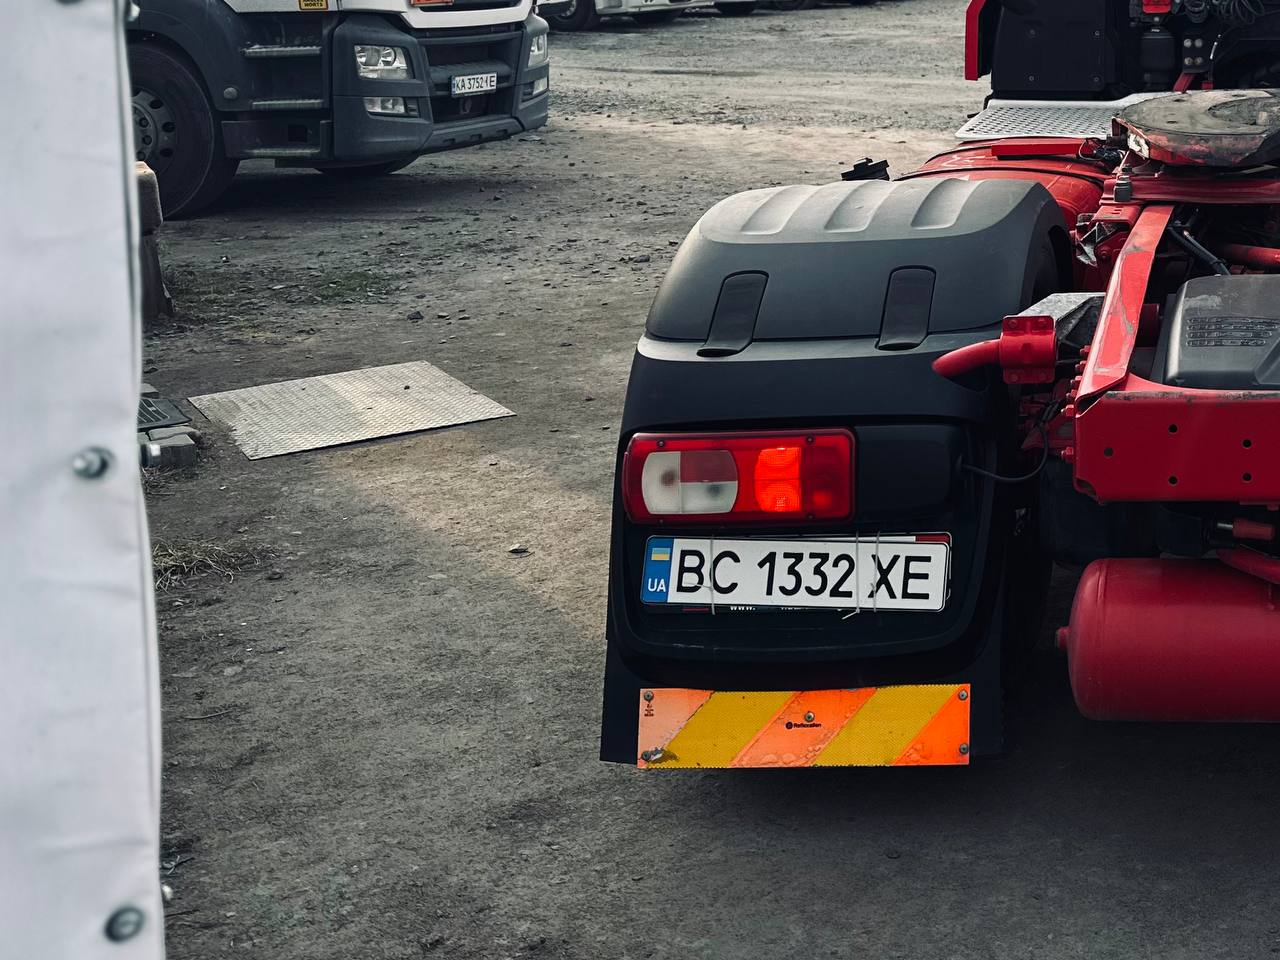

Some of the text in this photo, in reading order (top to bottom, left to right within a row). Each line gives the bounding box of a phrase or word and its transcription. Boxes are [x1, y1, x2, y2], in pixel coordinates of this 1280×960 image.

[455, 78, 466, 91] KA
[467, 76, 484, 90] 3752
[647, 549, 932, 600] UA BC 1332 XE
